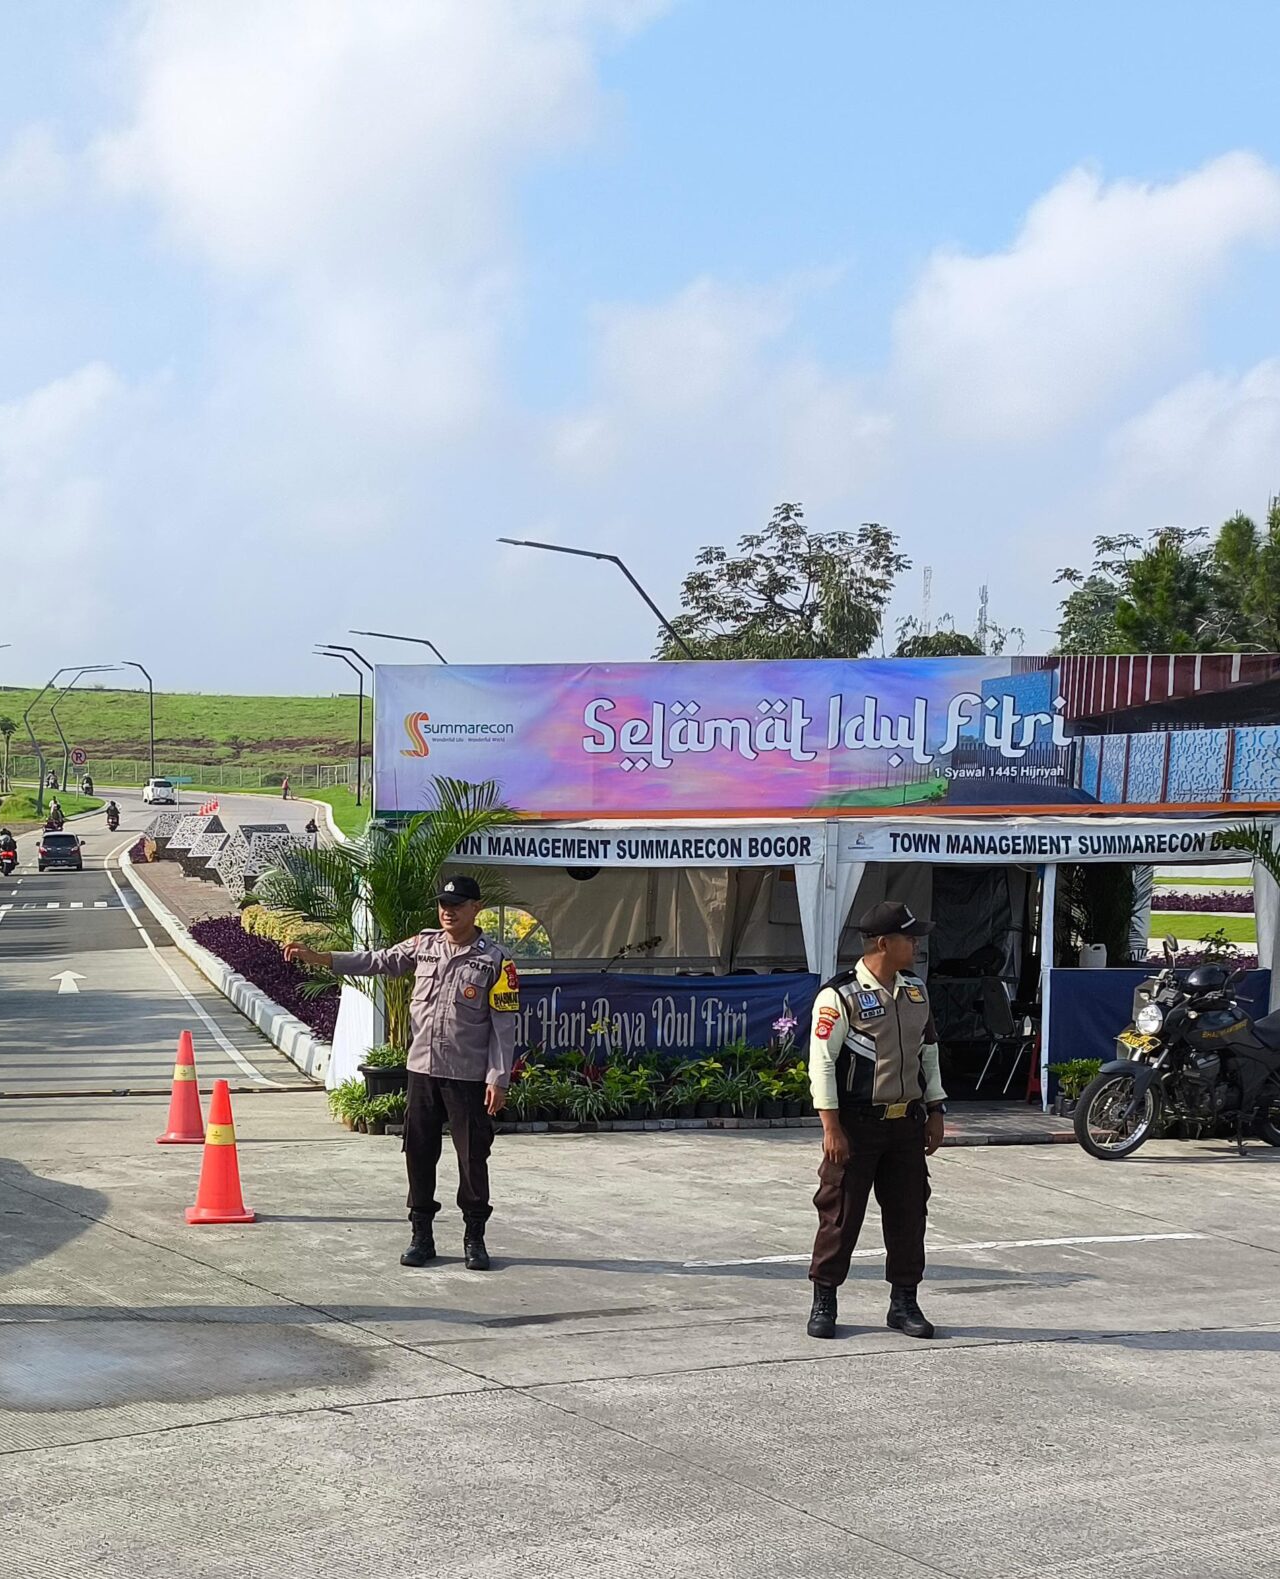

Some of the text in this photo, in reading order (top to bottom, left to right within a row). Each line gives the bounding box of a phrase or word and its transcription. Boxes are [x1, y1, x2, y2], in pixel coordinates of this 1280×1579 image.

[423, 723, 514, 734] summarecon
[827, 693, 934, 768] Idul
[939, 692, 1072, 758] Fitri
[934, 765, 1065, 780] 1 Syawal 1445 Hijriyah
[455, 836, 812, 860] WN MANAGEMENT SUMMARECON BOGOR
[889, 832, 941, 853] TOWN
[946, 834, 1073, 855] MANAGEMENT
[1078, 832, 1206, 855] SUMMARECON
[464, 960, 494, 974] POLRI
[536, 986, 586, 1054] Hari
[591, 997, 646, 1056] Raya
[651, 995, 696, 1047] Idul
[701, 997, 748, 1048] Fitri
